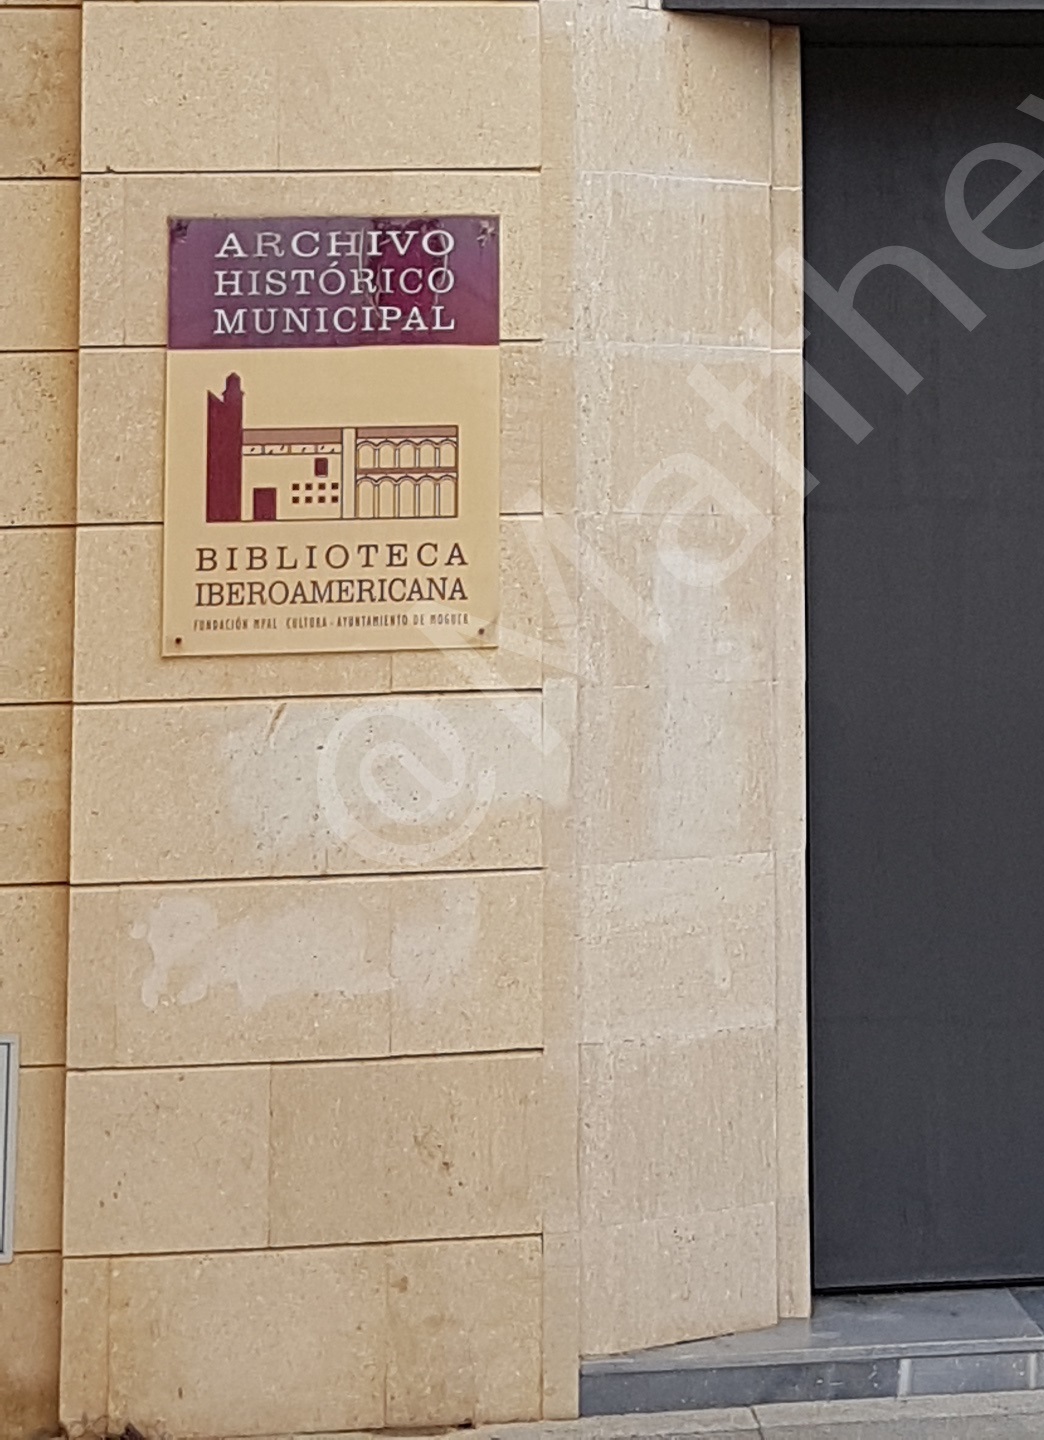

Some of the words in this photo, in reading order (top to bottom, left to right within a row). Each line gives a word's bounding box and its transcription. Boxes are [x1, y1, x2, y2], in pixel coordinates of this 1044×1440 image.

[214, 229, 455, 258] ARCHIVO
[213, 261, 455, 296] HISTÓRICO
[213, 306, 455, 335] MUNICIPAL
[195, 542, 469, 572] BIBLIOTECA
[195, 577, 468, 607] IBEROAMERICANA
[193, 616, 249, 631] FUNDACIÓN
[286, 616, 327, 629] CULTURA
[336, 614, 408, 627] AYUNTAMIENTO
[413, 613, 425, 626] DE
[430, 613, 469, 626] MOGUER
